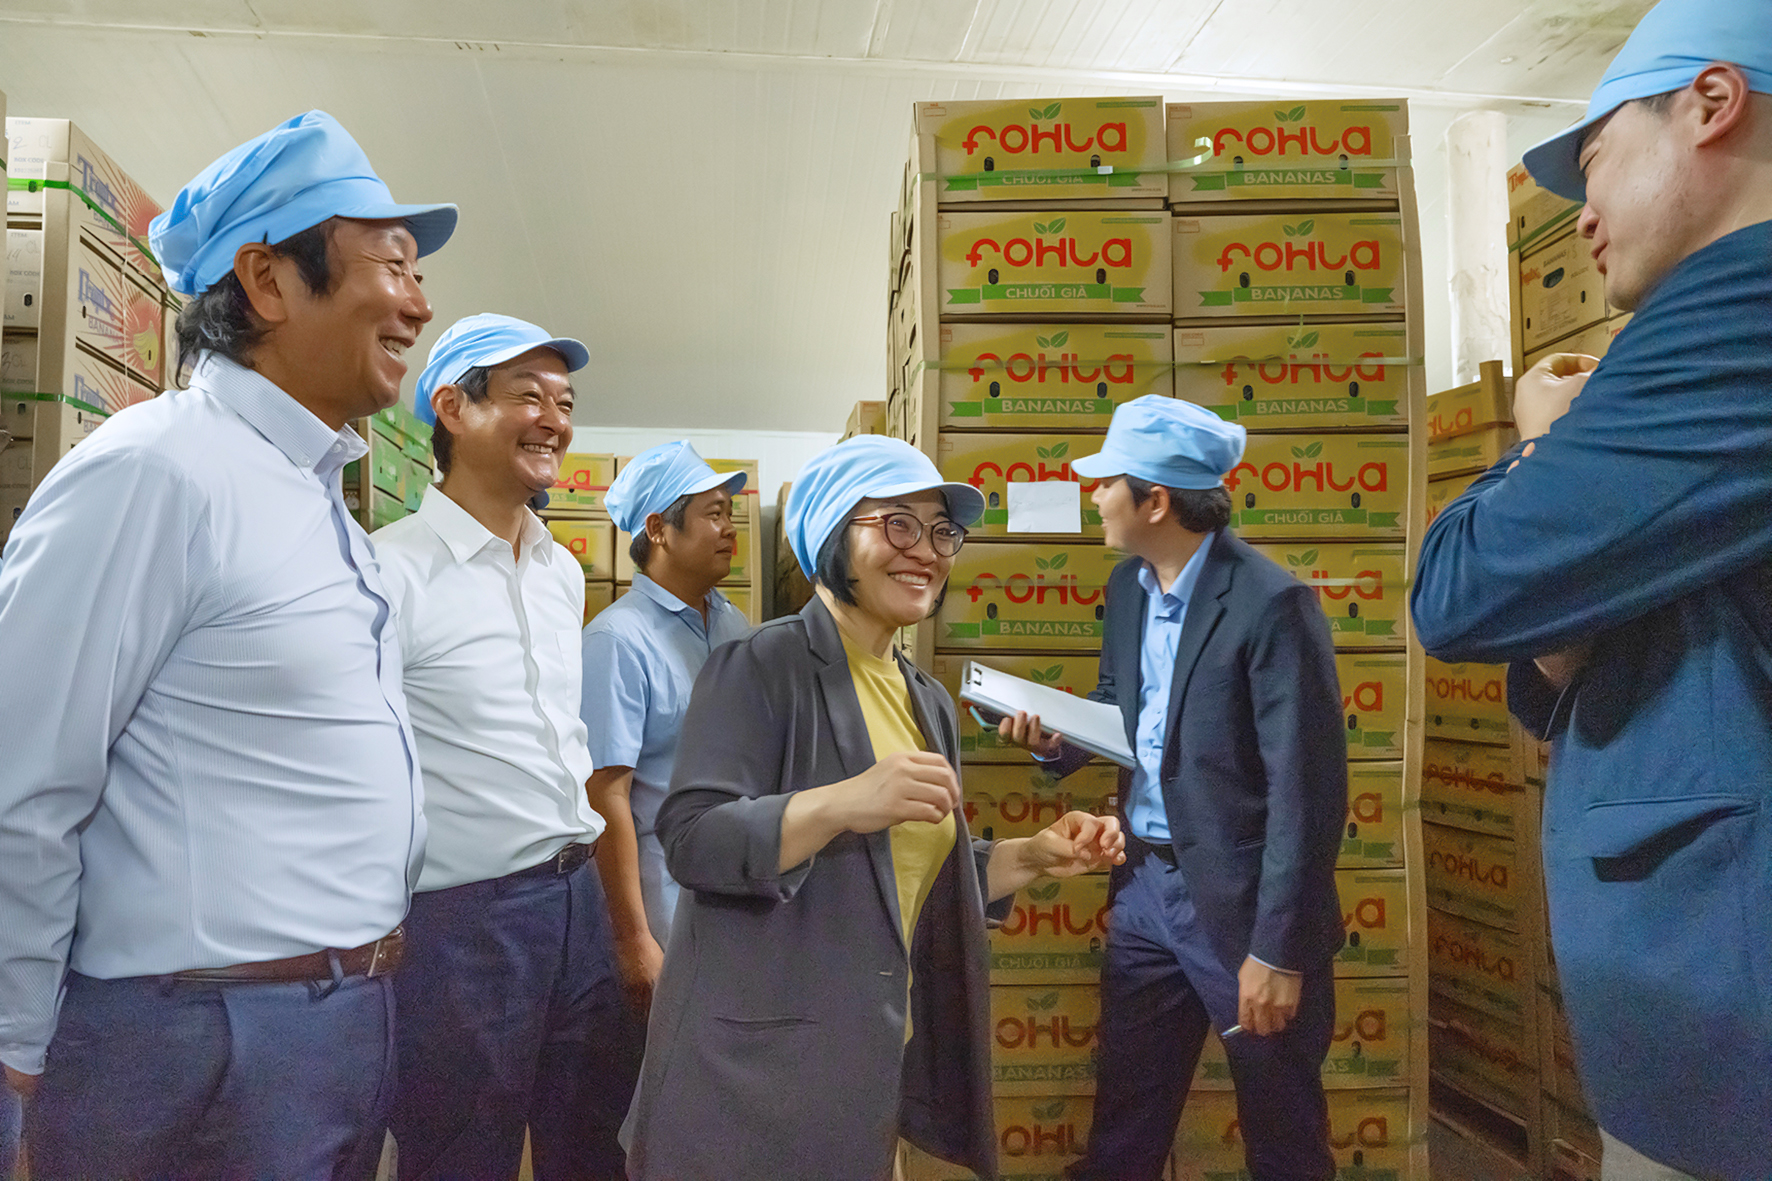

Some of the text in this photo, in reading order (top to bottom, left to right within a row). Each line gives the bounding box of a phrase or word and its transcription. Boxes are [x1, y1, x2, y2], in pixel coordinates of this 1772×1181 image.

[1243, 171, 1337, 185] BANANAS
[1251, 285, 1344, 301] BANANAS
[1001, 399, 1095, 413] BANANAS
[1256, 398, 1349, 414] BANANAS
[1000, 621, 1094, 635] BANANAS
